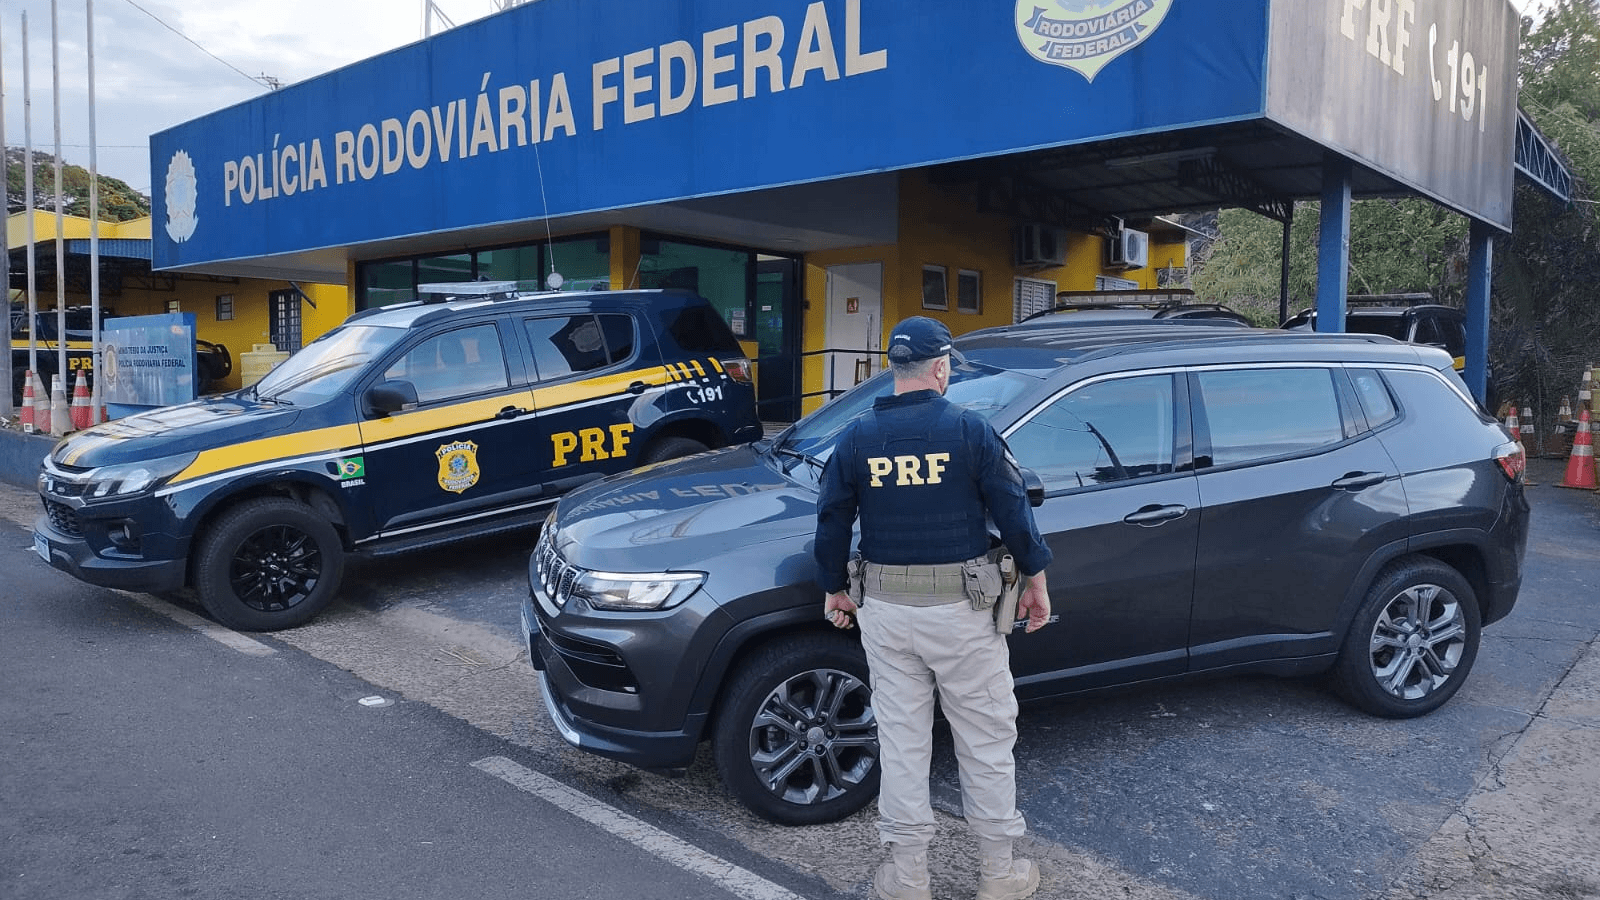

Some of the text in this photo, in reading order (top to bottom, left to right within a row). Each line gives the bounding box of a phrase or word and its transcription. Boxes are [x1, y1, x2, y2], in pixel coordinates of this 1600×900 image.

[1039, 0, 1148, 37] RODOVIÁRIA
[1052, 33, 1131, 58] FEDERAL
[1448, 40, 1487, 132] 191
[224, 0, 888, 207] POLÍCIA RODOVIÁRIA FEDERAL
[68, 357, 93, 370] PR
[161, 358, 185, 368] FEDERAL
[697, 386, 723, 403] 191
[550, 422, 636, 468] PRF
[340, 478, 366, 489] BRASIL
[867, 452, 950, 488] PRF
